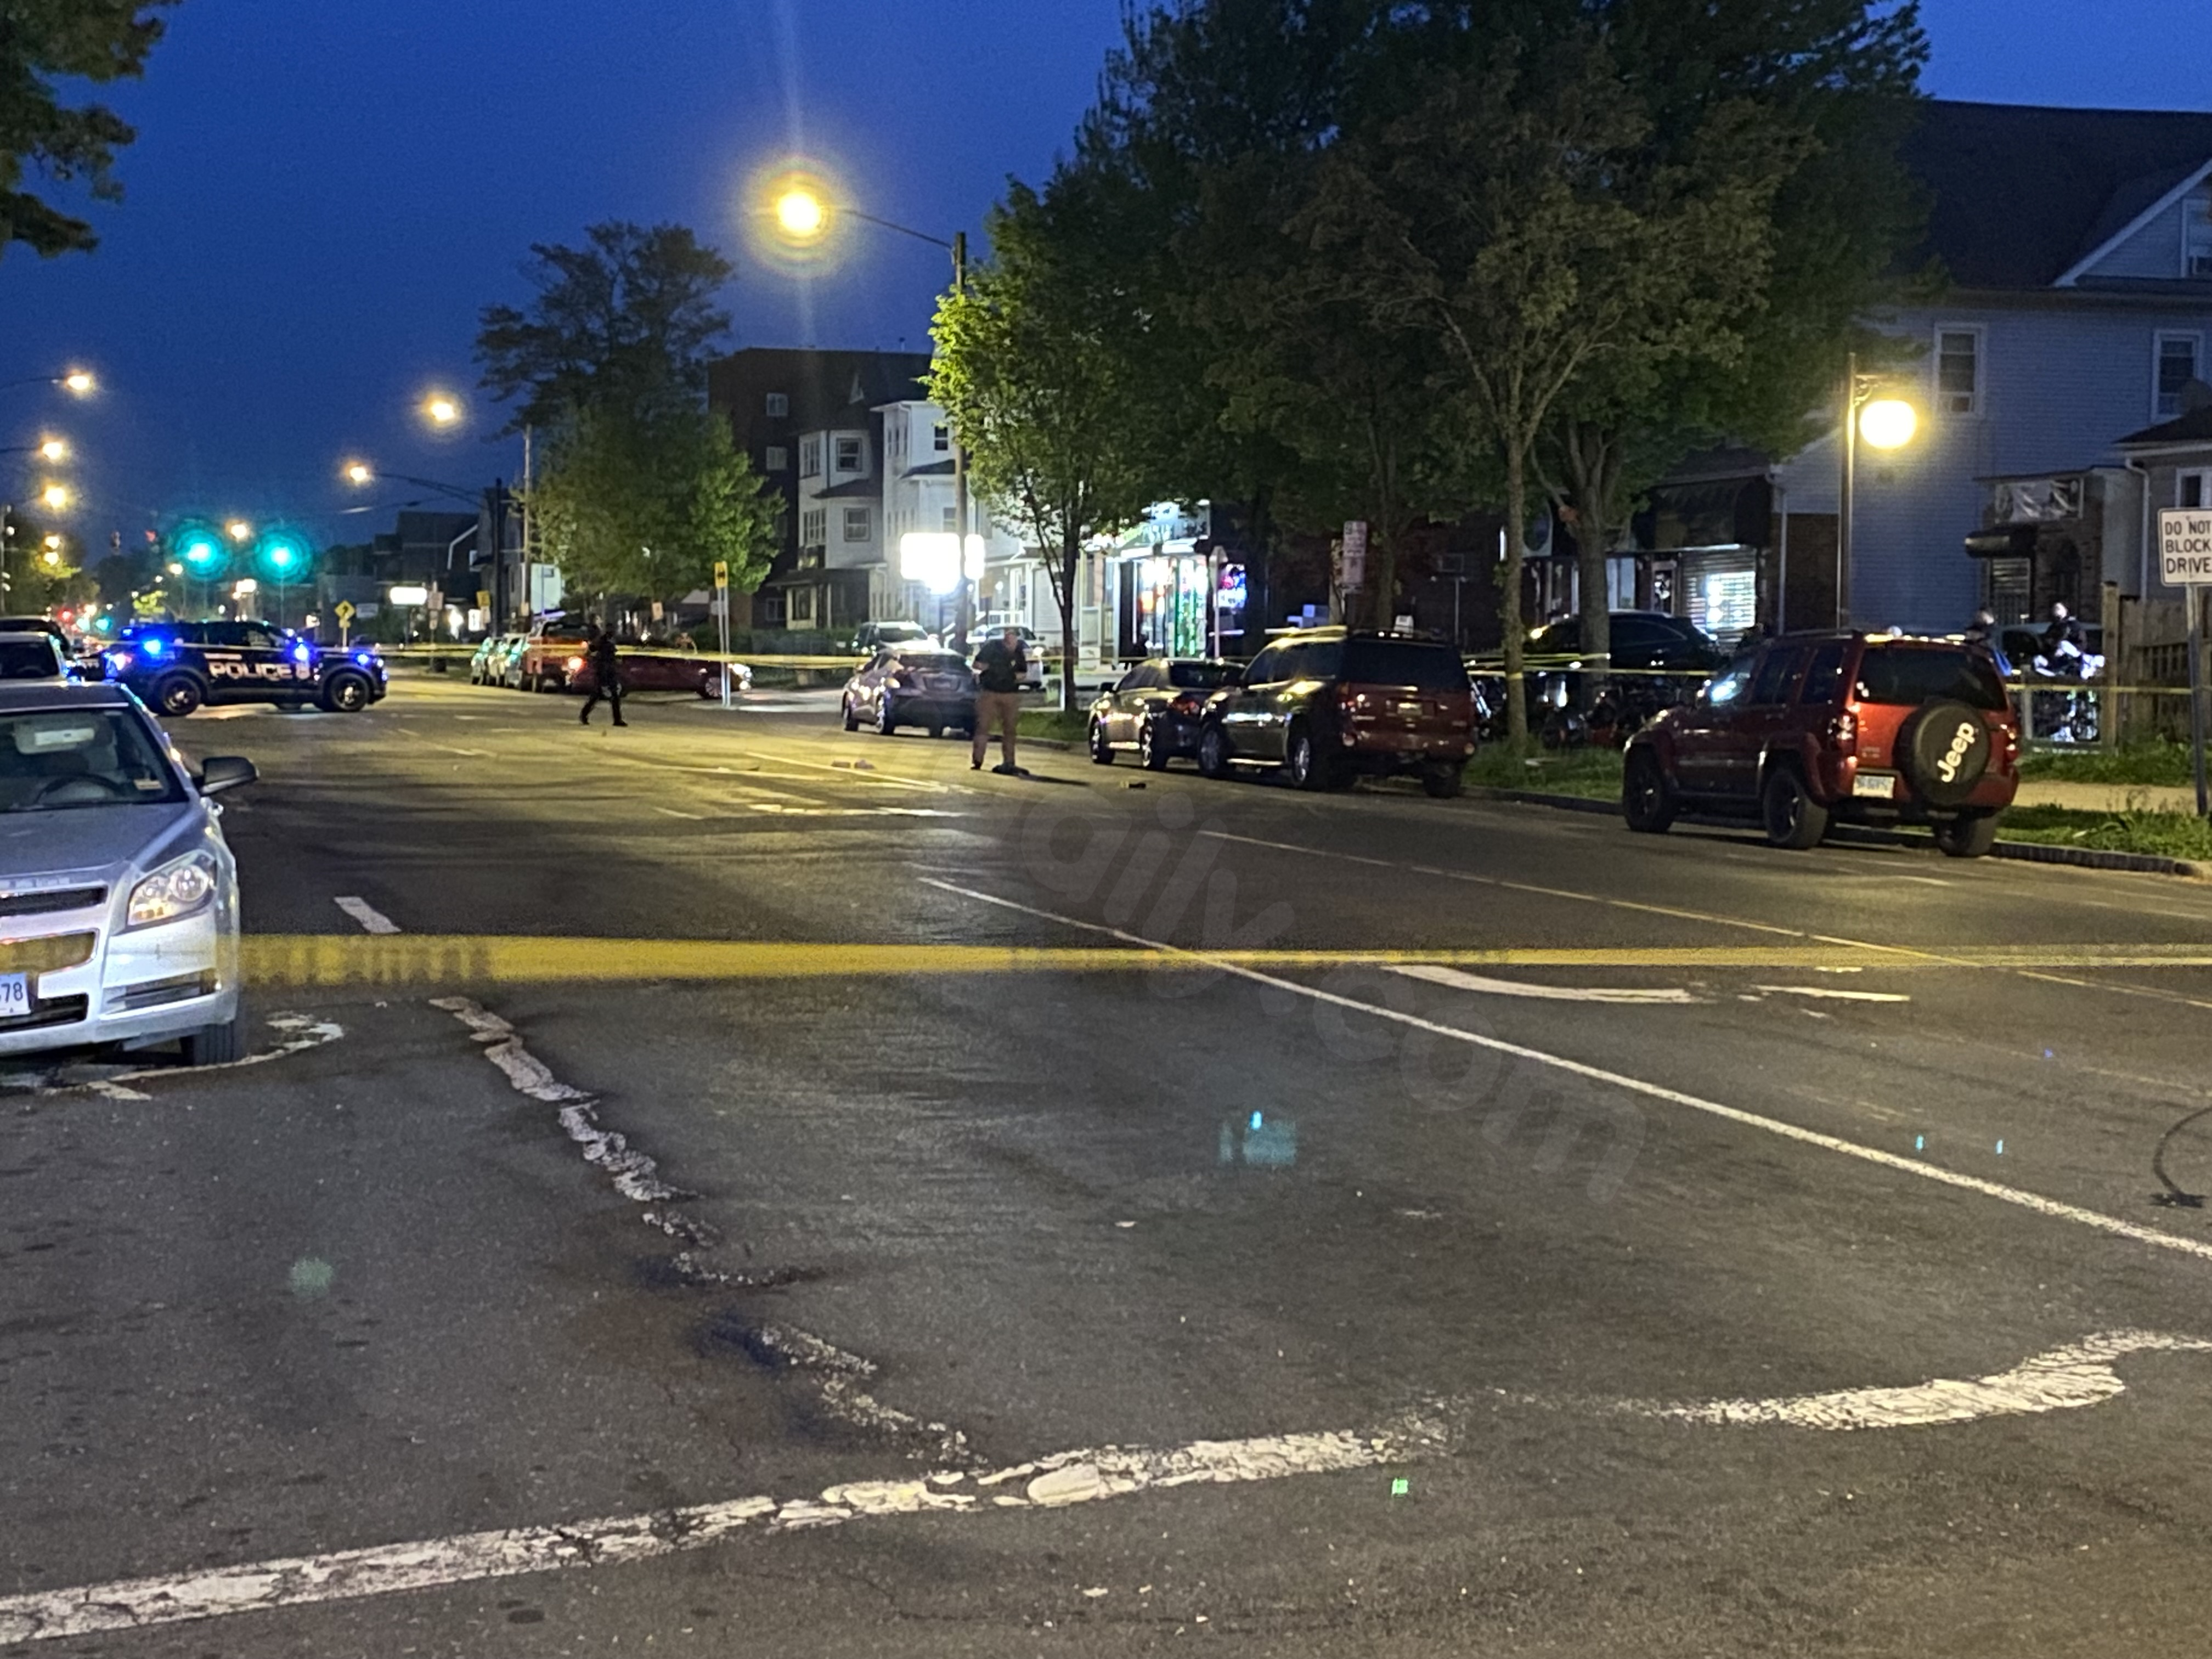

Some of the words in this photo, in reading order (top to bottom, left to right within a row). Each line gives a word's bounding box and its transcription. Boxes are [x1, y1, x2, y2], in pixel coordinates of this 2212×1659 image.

[2165, 522, 2182, 535] DO
[2189, 520, 2211, 534] NOT
[2165, 539, 2212, 553] BLOCK
[208, 662, 292, 681] POLICE
[1937, 723, 1975, 782] Jeep
[0, 982, 23, 1003] 78
